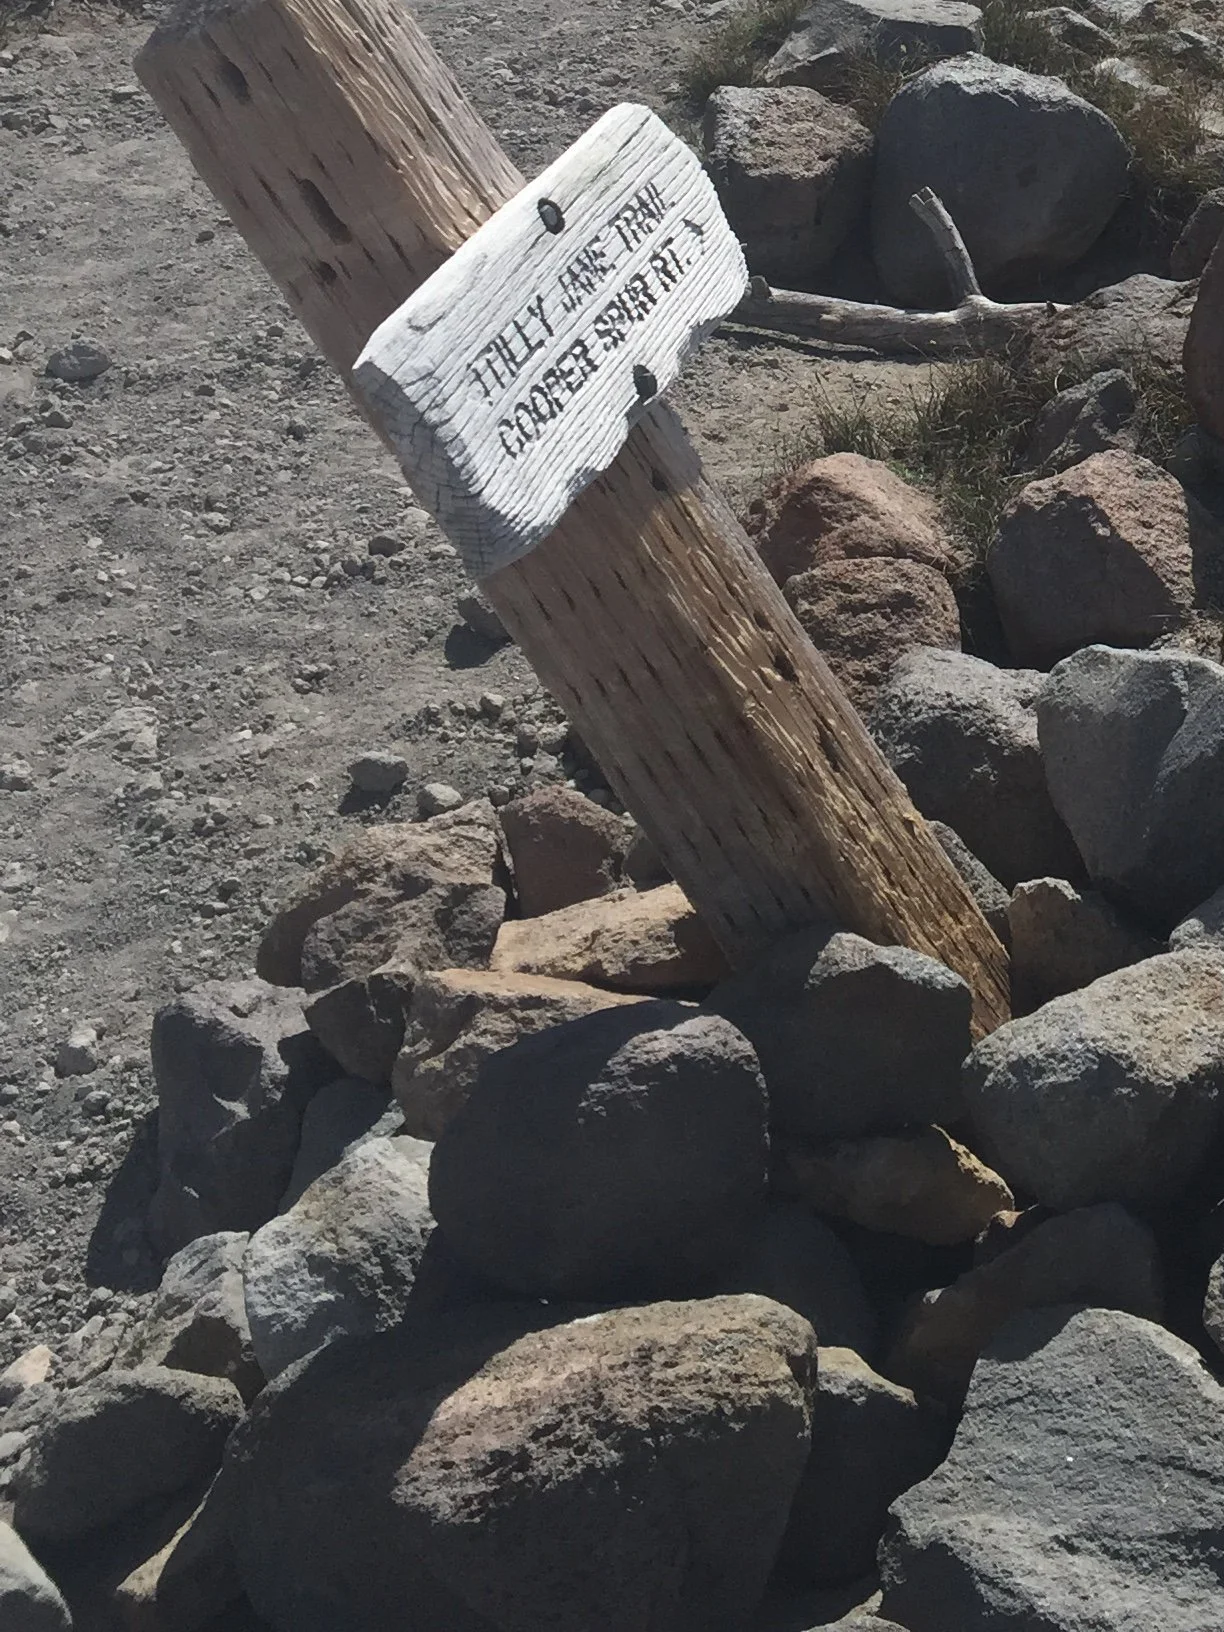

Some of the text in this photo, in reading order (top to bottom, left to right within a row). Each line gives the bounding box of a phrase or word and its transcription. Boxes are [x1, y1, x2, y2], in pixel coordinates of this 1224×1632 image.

[558, 235, 616, 313] JANE
[608, 182, 676, 253] TRAIL
[498, 236, 692, 460] COOPER SPUR RT.
